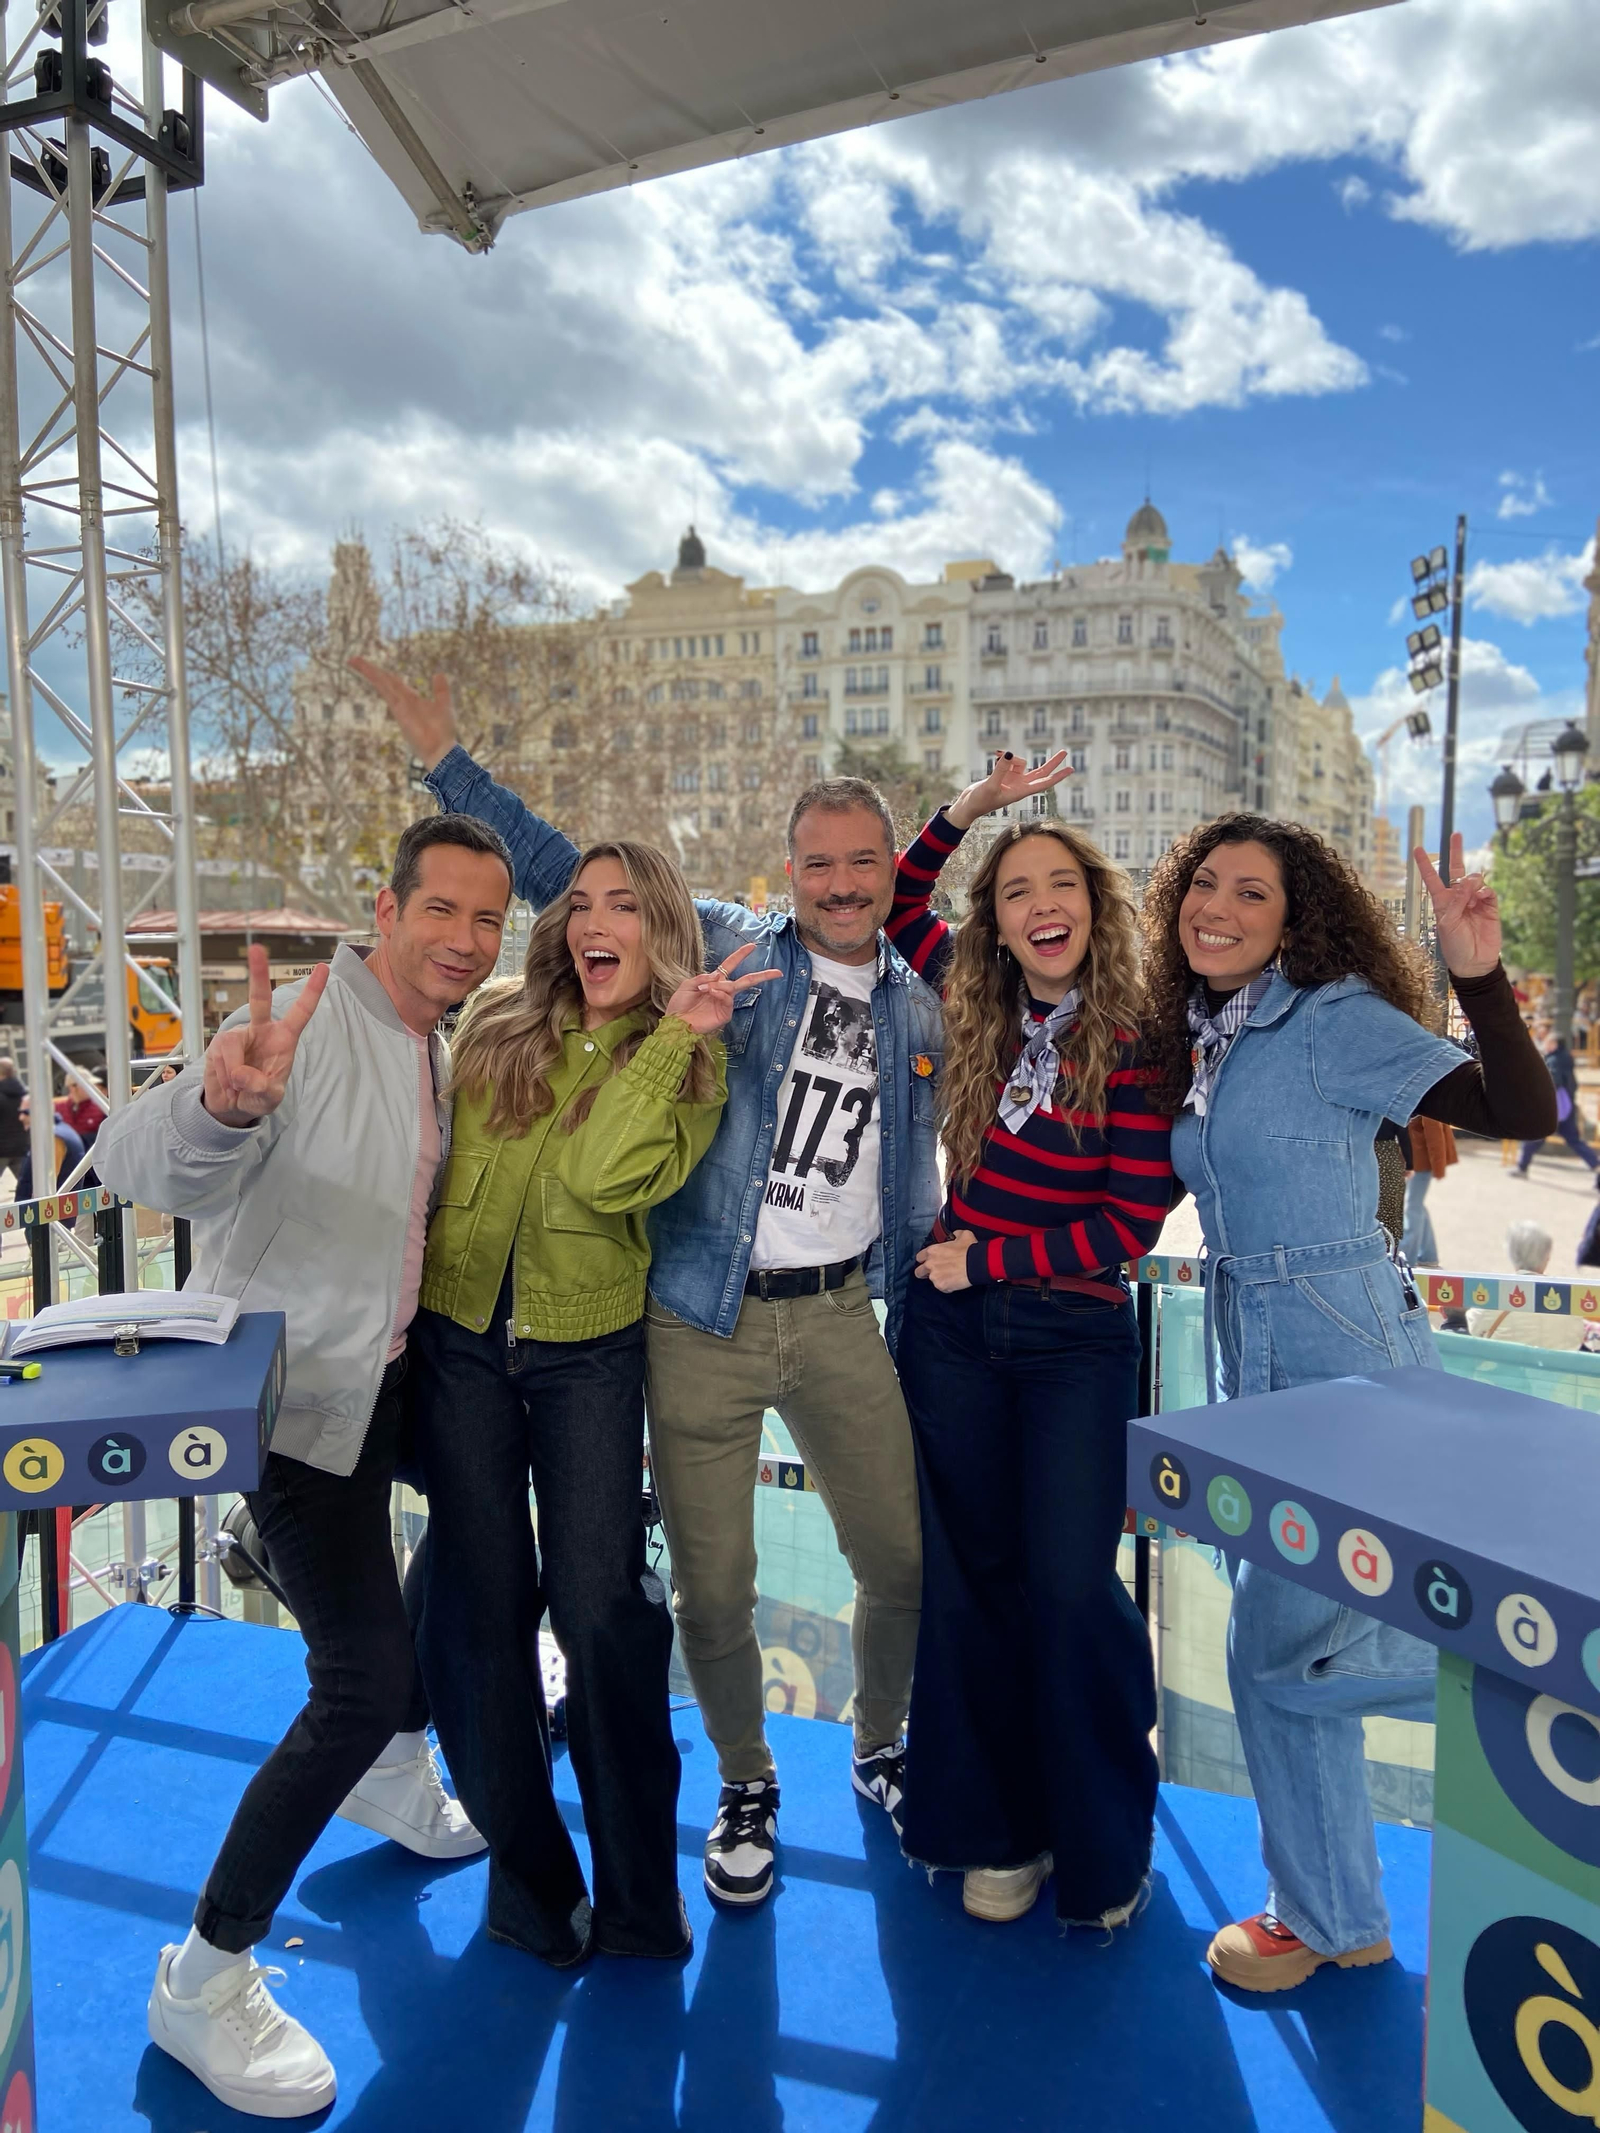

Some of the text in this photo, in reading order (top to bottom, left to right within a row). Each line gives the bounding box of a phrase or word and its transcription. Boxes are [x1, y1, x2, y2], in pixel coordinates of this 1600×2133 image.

[772, 1069, 872, 1188] 173
[19, 1433, 211, 1480] à à à
[1159, 1457, 1538, 1651] à à à à à à
